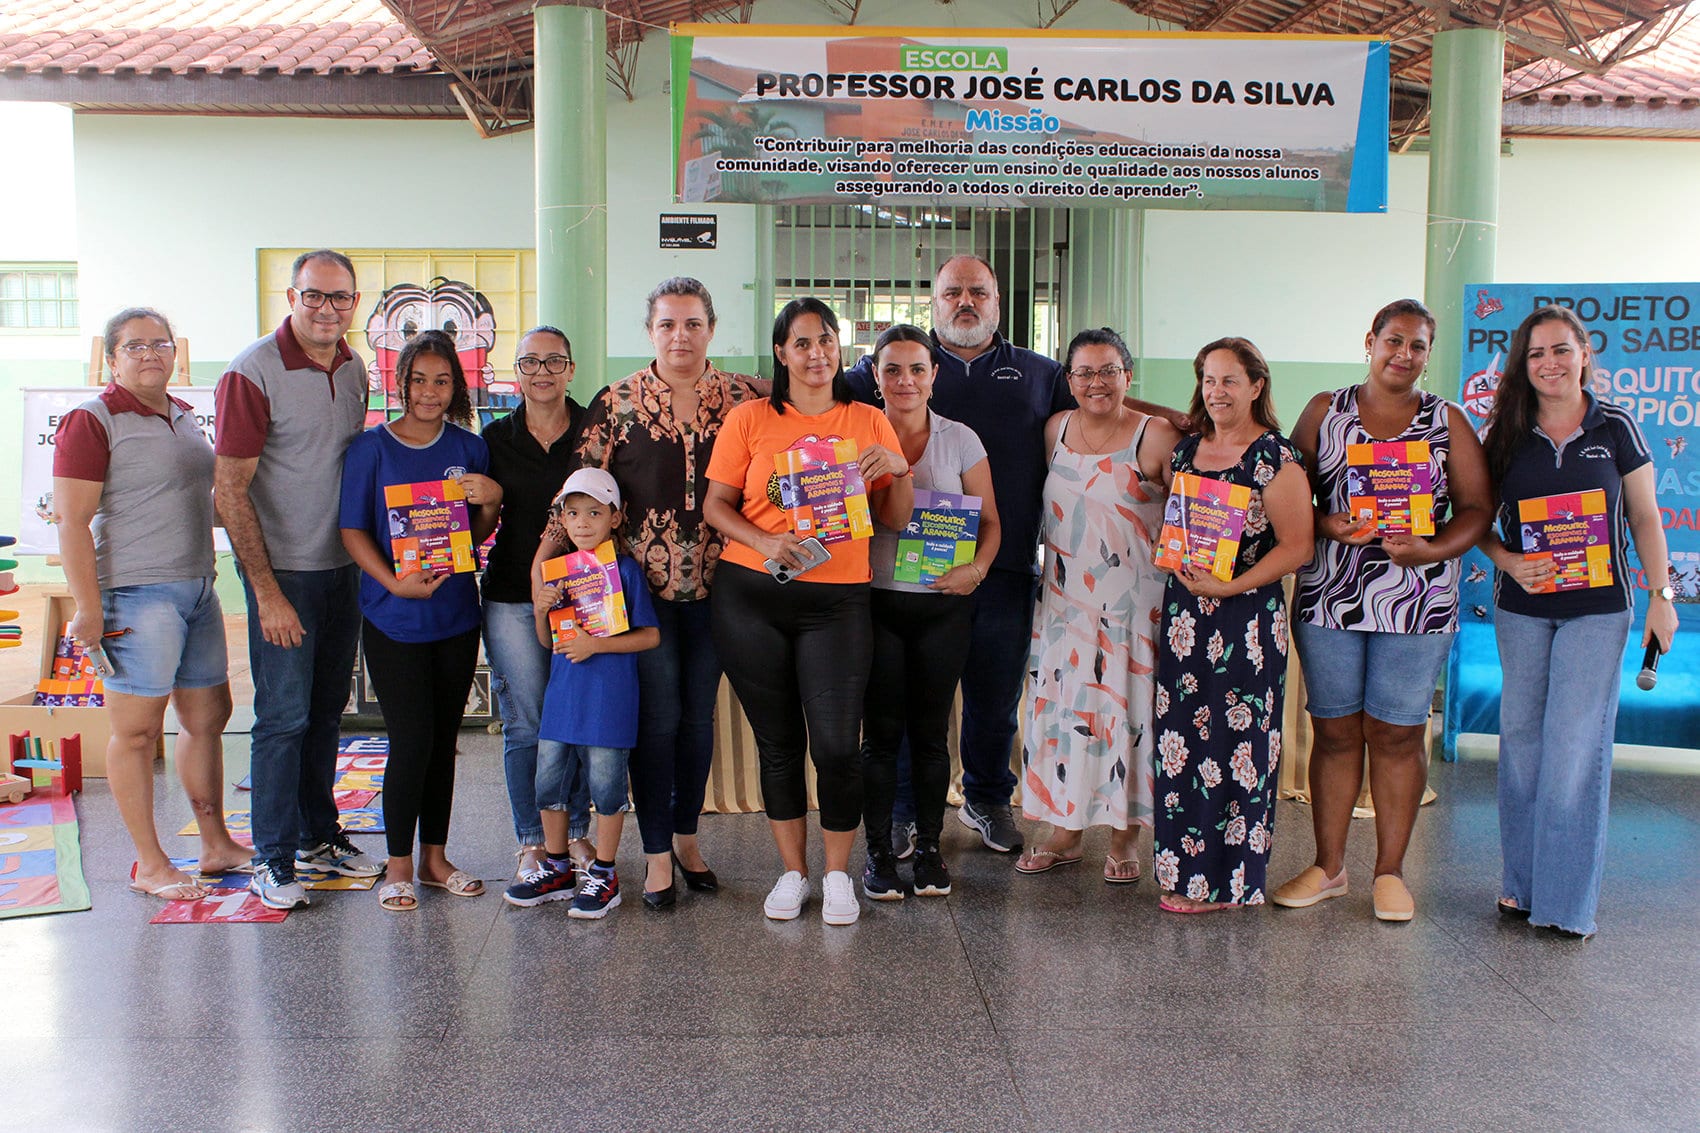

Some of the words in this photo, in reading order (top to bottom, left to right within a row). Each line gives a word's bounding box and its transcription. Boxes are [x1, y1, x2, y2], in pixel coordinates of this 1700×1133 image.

[906, 51, 1002, 69] ESCOLA
[756, 73, 955, 99] PROFESSOR
[963, 67, 1044, 100] JOSÉ
[1053, 77, 1182, 102] CARLOS
[1192, 80, 1235, 103] DA
[1244, 81, 1335, 106] SILVA
[965, 108, 1060, 133] Missão
[755, 138, 852, 152] “Contribuir
[856, 142, 894, 156] para
[899, 140, 973, 154] melhoria
[978, 141, 1007, 154] das
[1012, 141, 1094, 159] condições
[1098, 143, 1205, 158] educacionais
[1210, 145, 1230, 158] da
[1235, 148, 1281, 159] nossa
[716, 159, 823, 174] comunidade,
[827, 160, 892, 173] visando
[896, 161, 969, 174] oferecer
[973, 164, 999, 174] um
[1003, 162, 1058, 175] ensino
[1062, 163, 1082, 176] de
[1087, 163, 1168, 179] qualidade
[1172, 167, 1201, 178] aos
[1206, 167, 1261, 178] nossos
[1265, 165, 1319, 179] alunos
[836, 181, 943, 196] assegurando
[948, 184, 958, 194] a
[962, 182, 1010, 194] todos
[1014, 185, 1024, 194] o
[1028, 181, 1084, 195] direito
[1089, 183, 1109, 196] de
[1113, 184, 1202, 200] aprender”.
